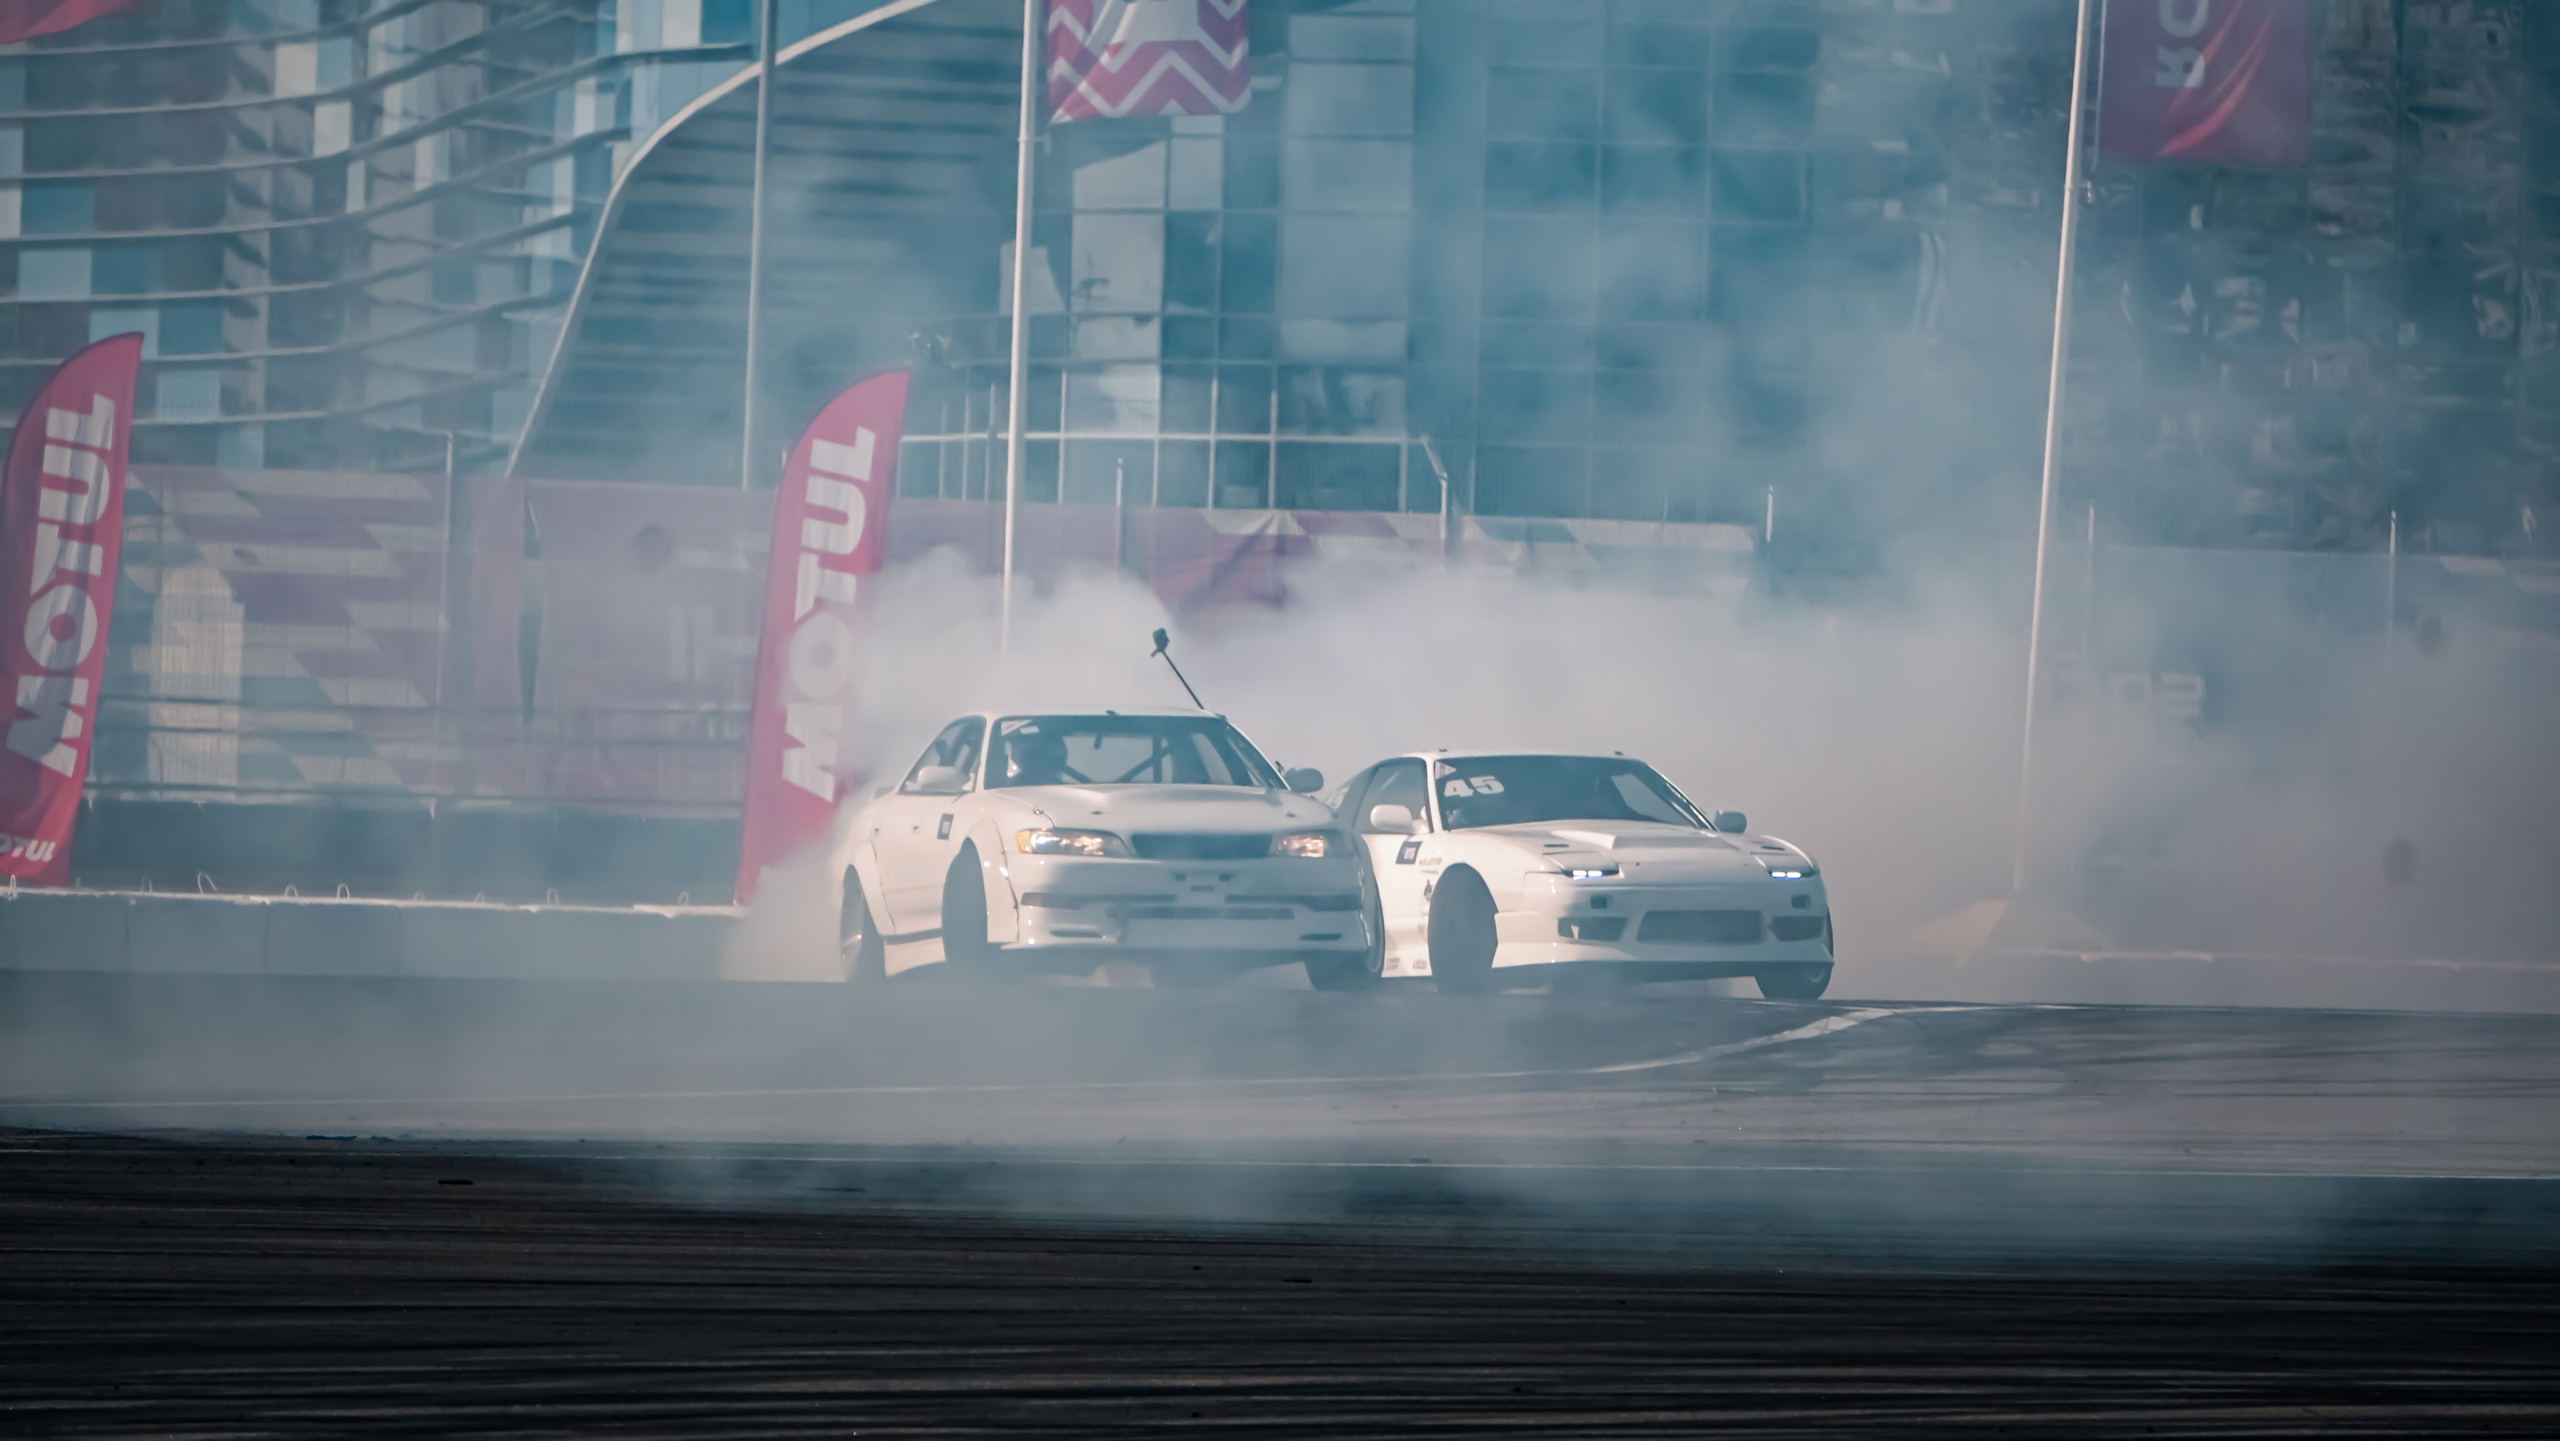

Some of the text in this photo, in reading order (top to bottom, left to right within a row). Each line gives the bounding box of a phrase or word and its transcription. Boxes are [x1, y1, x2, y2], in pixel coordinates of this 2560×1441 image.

[6, 393, 115, 779] MOTUL
[782, 425, 878, 804] MOTUL
[1443, 775, 1505, 798] 45
